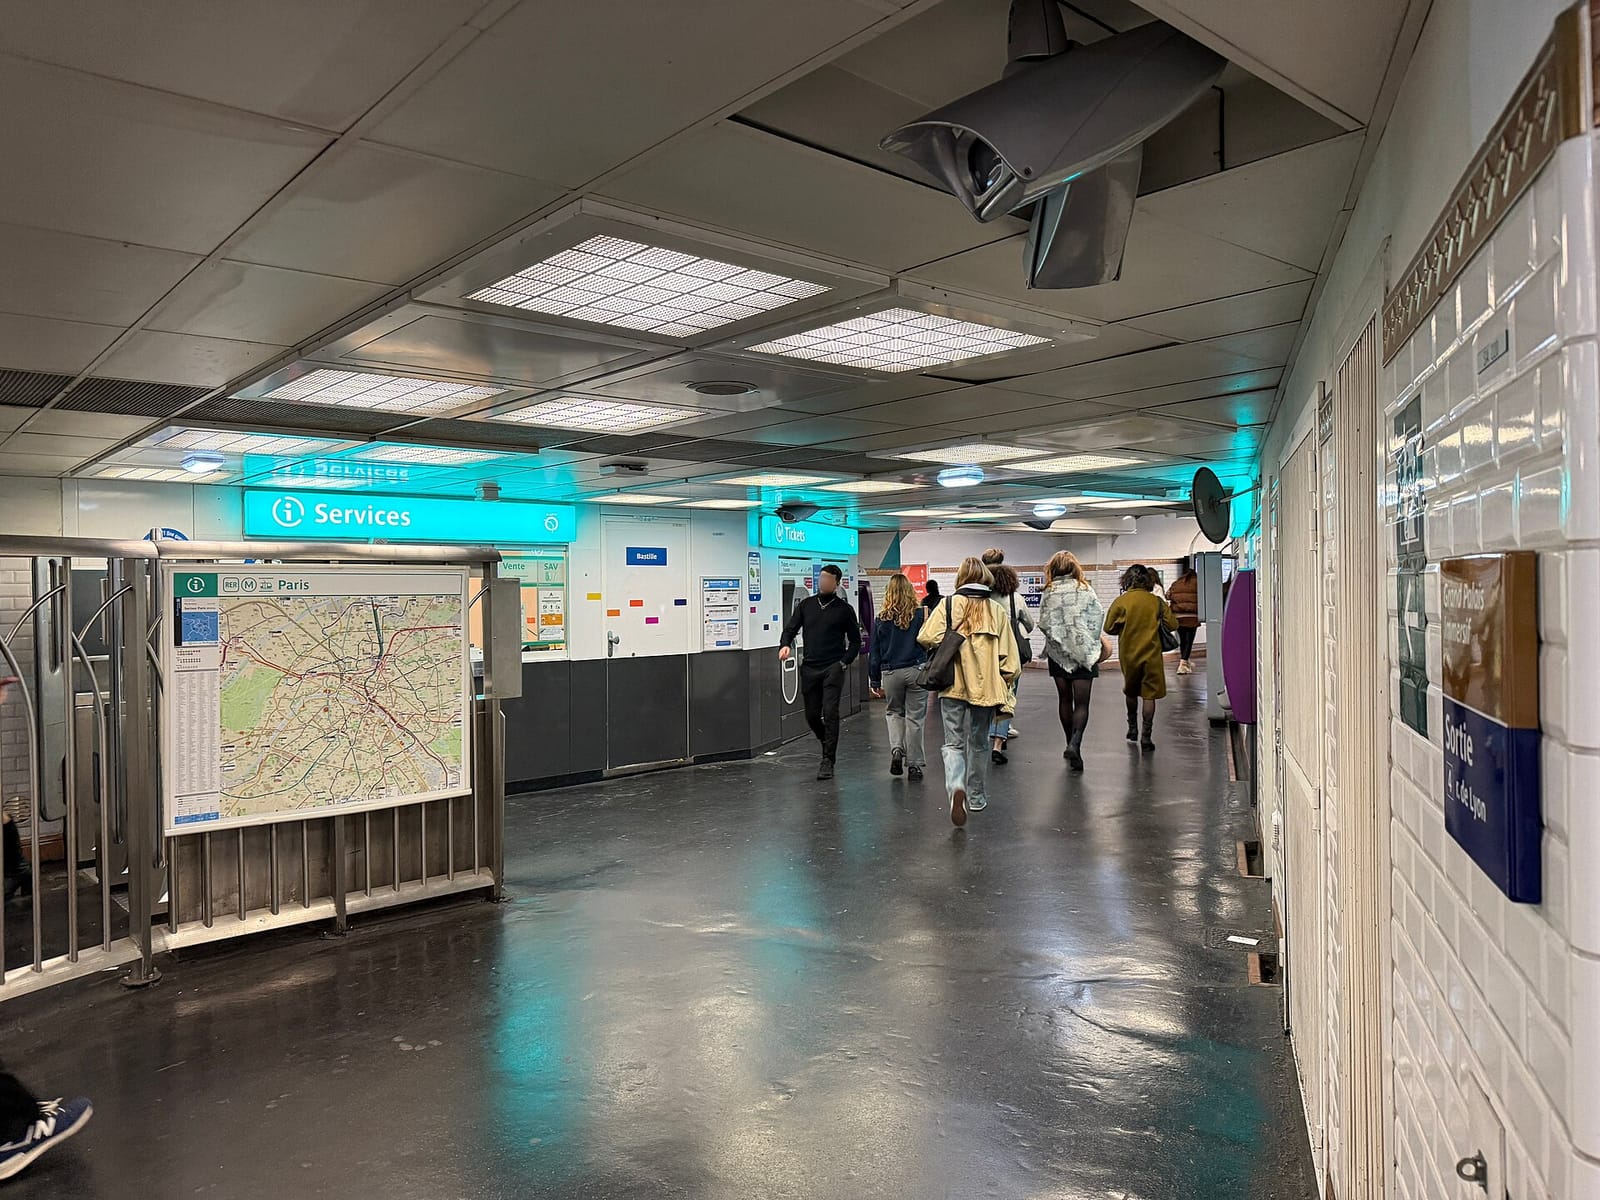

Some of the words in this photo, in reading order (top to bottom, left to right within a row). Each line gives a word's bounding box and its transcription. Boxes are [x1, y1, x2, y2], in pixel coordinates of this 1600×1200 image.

[314, 503, 411, 527] Services
[785, 526, 805, 542] Tickets
[636, 552, 657, 560] Bastille
[502, 562, 526, 570] Vente
[543, 562, 559, 571] SAV
[278, 579, 310, 591] Paris
[1445, 713, 1473, 767] Sortie
[1460, 779, 1469, 808] de
[1469, 786, 1487, 823] Lyon
